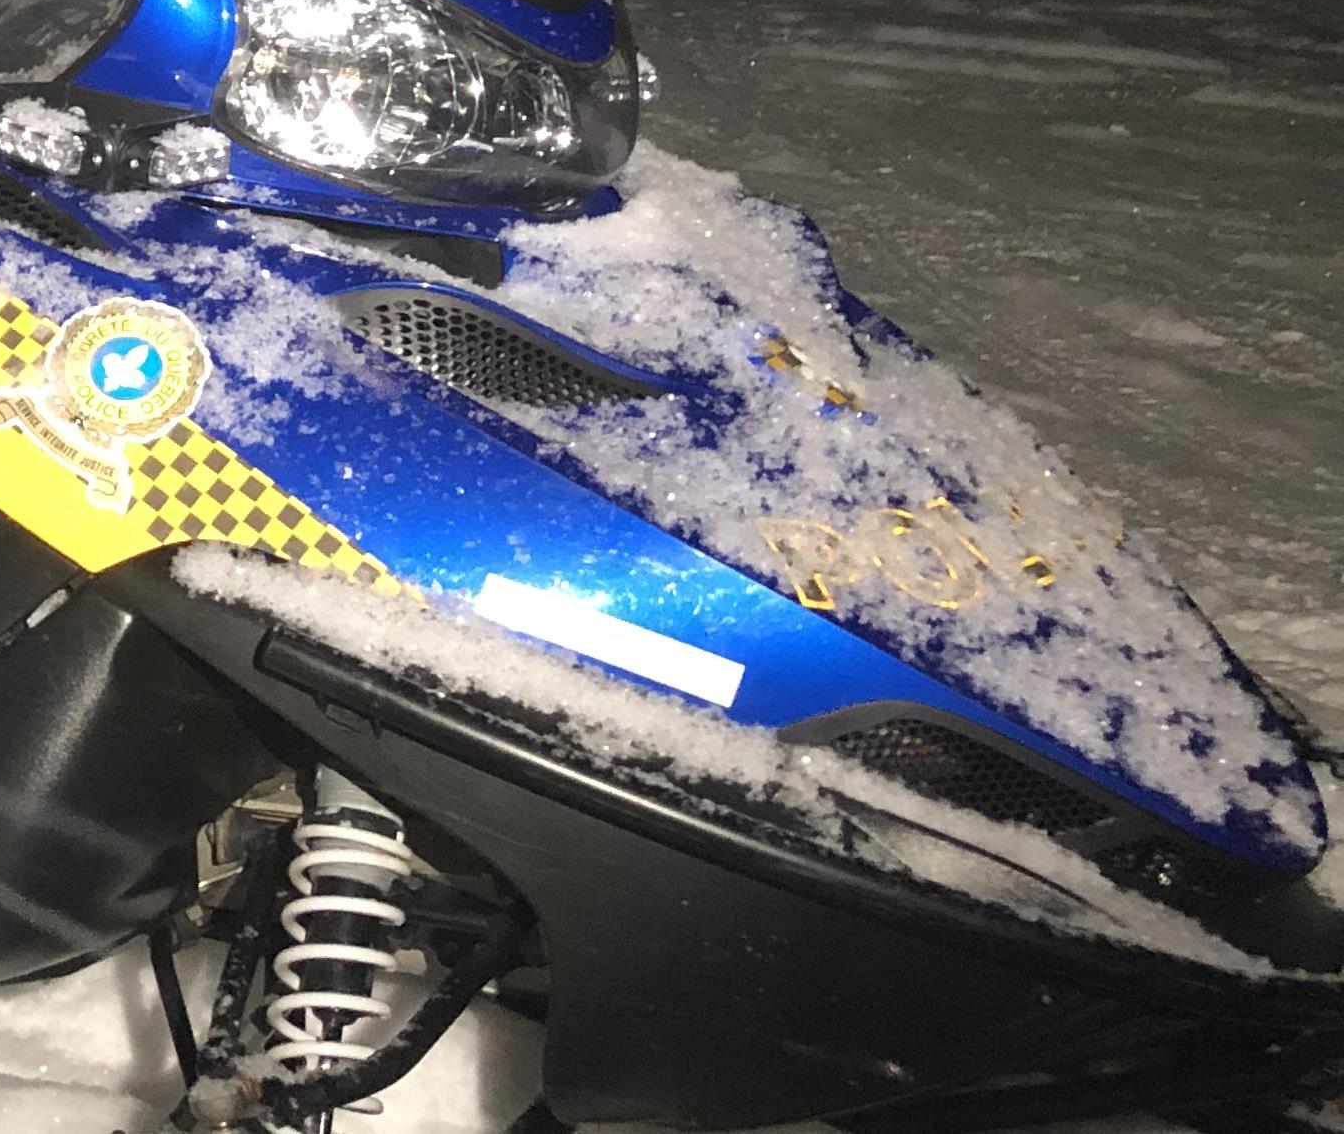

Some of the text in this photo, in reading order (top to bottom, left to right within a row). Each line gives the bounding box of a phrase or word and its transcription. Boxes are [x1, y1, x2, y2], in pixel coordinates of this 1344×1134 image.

[73, 374, 130, 419] POLICE
[15, 397, 42, 428] SERVICE
[79, 456, 116, 478] JUSTICE
